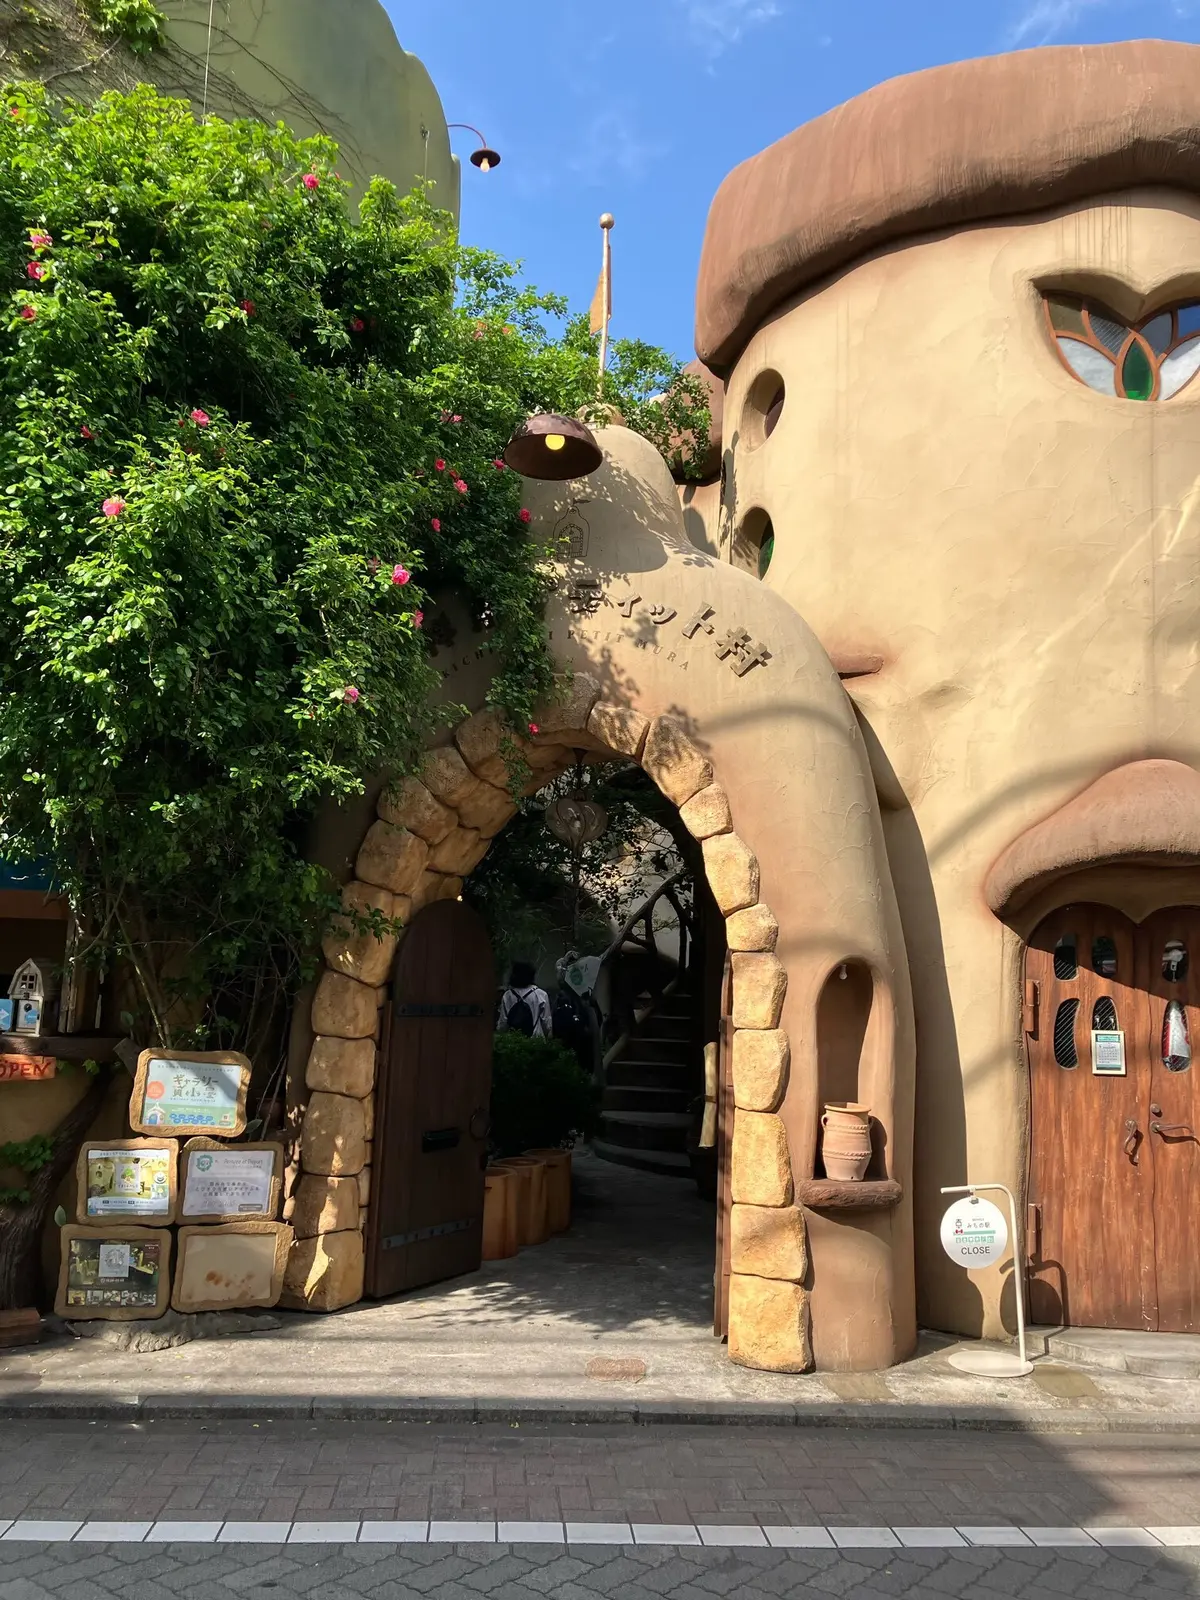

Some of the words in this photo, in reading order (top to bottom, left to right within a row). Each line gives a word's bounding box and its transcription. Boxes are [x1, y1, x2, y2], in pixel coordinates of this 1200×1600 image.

[567, 629, 625, 644] PETIT
[636, 638, 690, 672] MURA
[173, 1074, 219, 1087] ギャラリー
[961, 1246, 991, 1255] CLOSE
